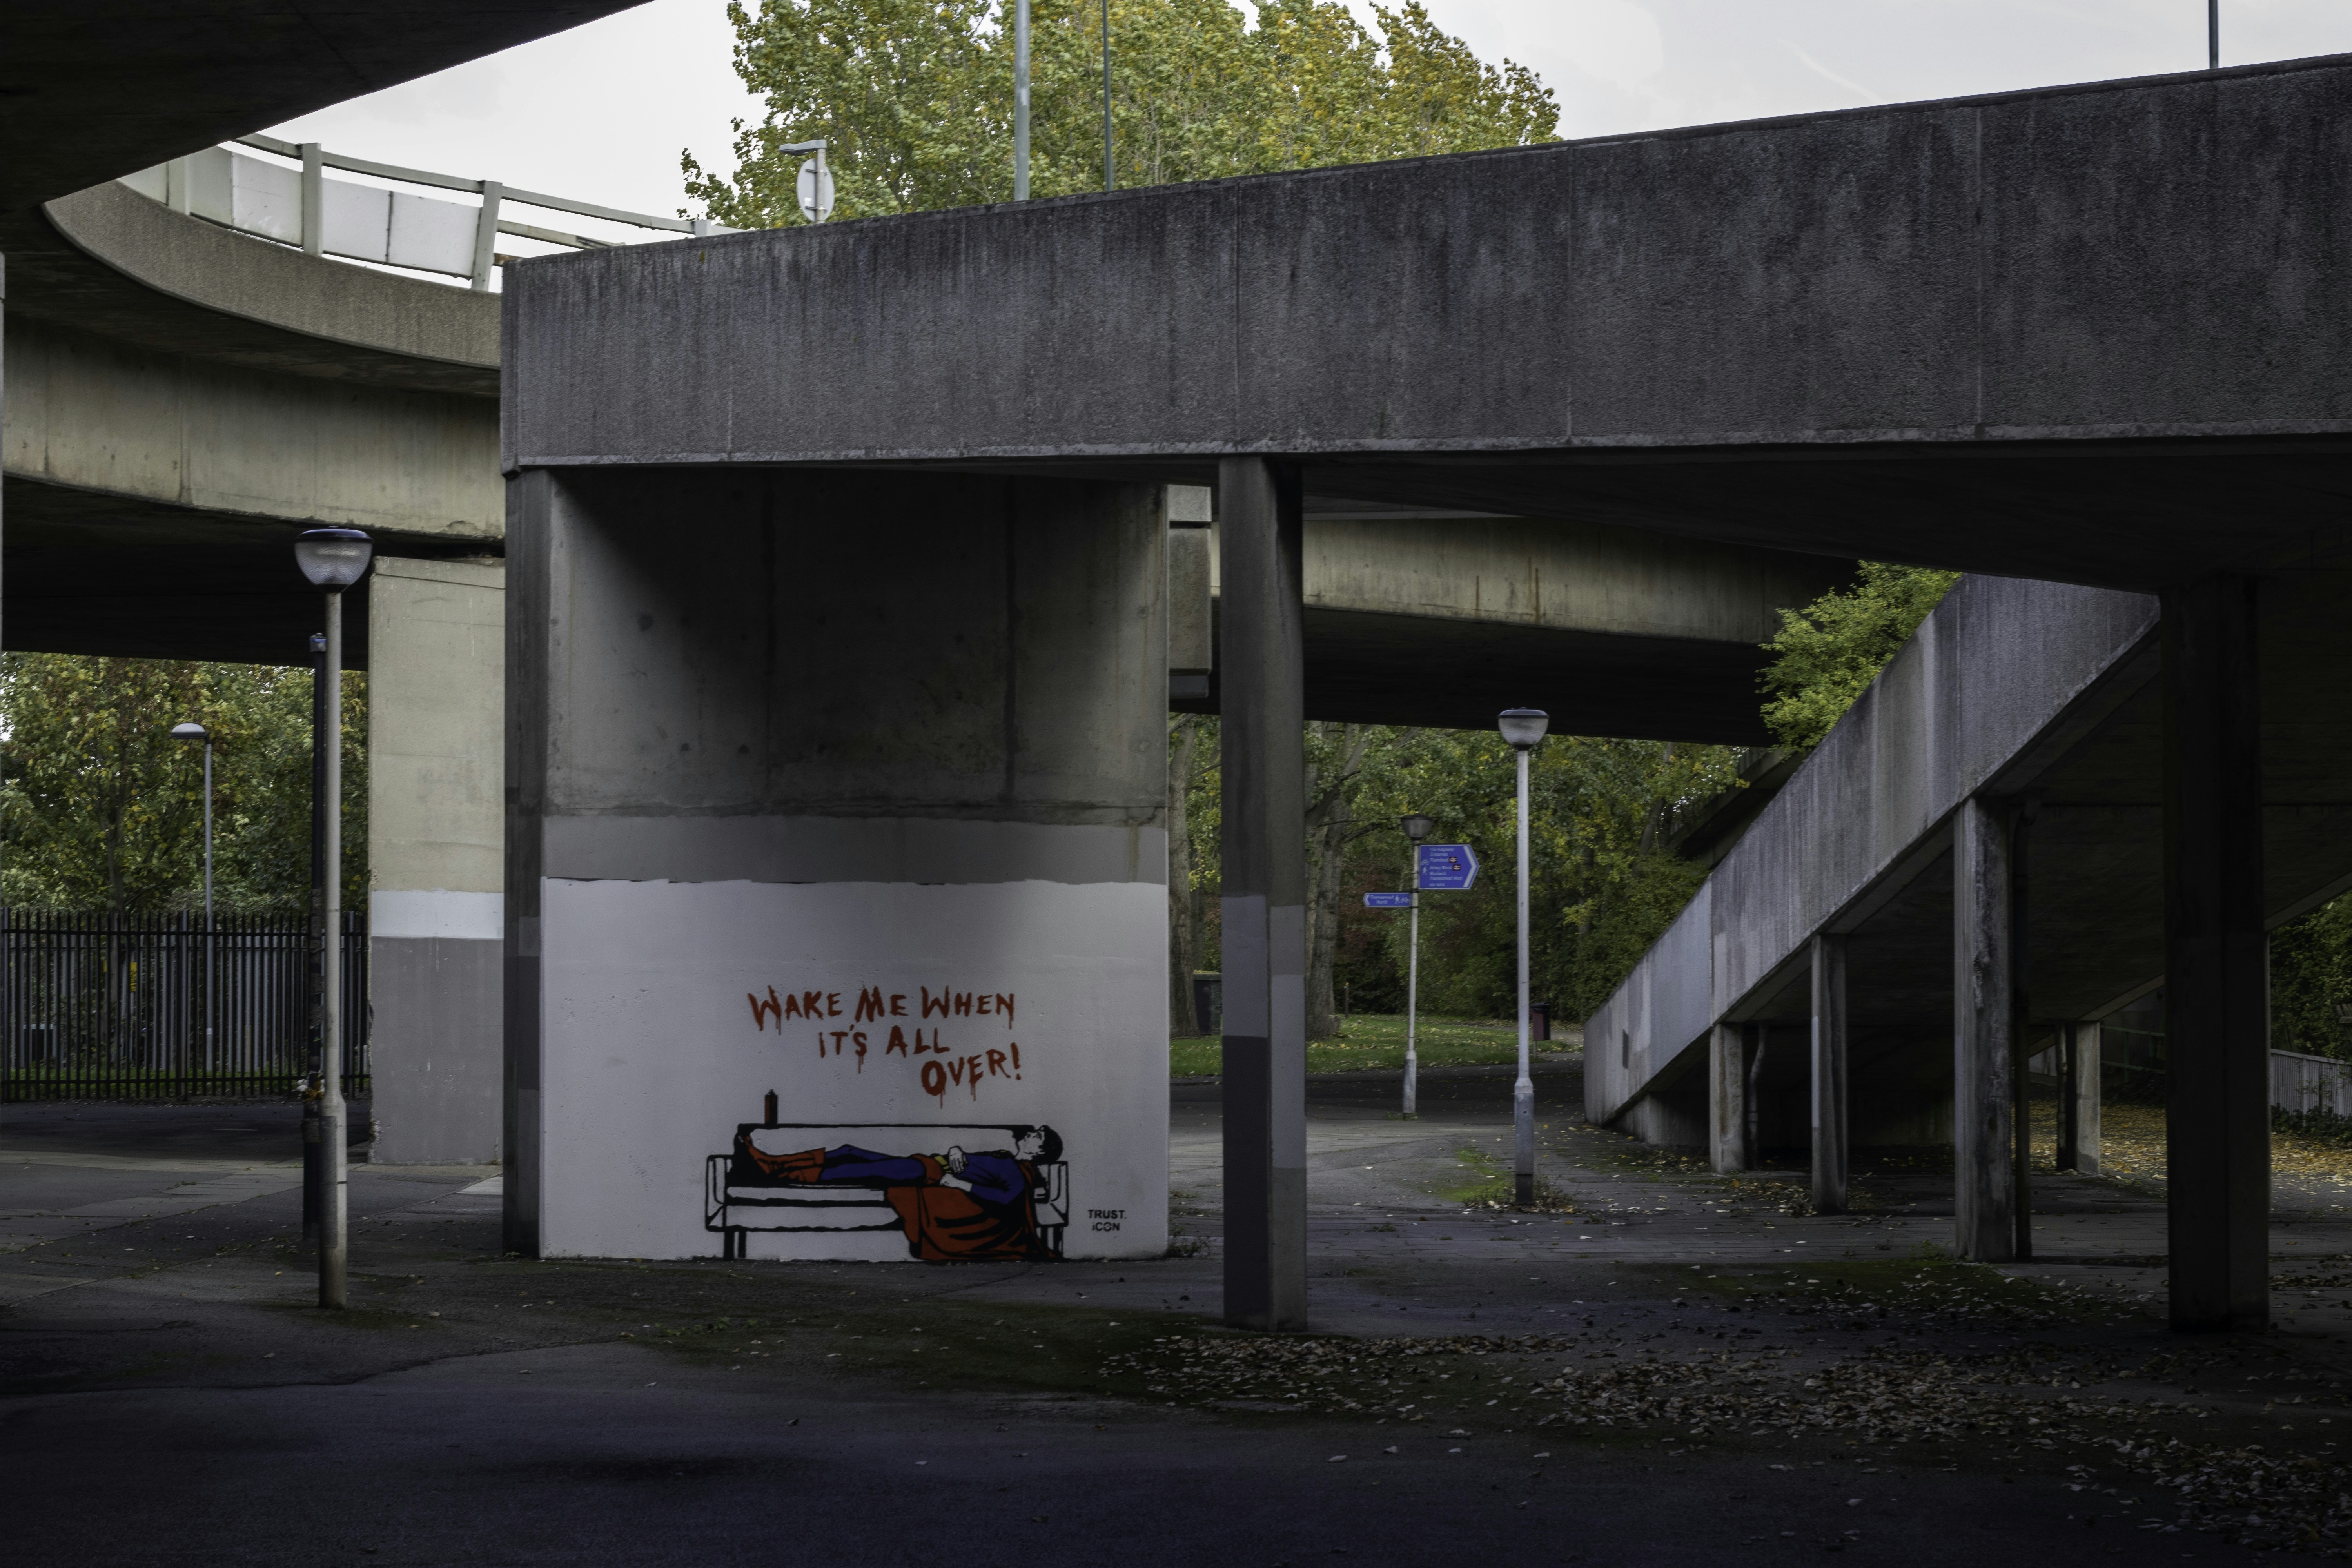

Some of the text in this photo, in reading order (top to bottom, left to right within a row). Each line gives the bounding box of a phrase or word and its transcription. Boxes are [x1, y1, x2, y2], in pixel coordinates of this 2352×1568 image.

[748, 985, 1015, 1032] WAKE ME WHEN
[818, 1024, 950, 1060] IT'S ALL
[920, 1042, 1022, 1097] OVER!
